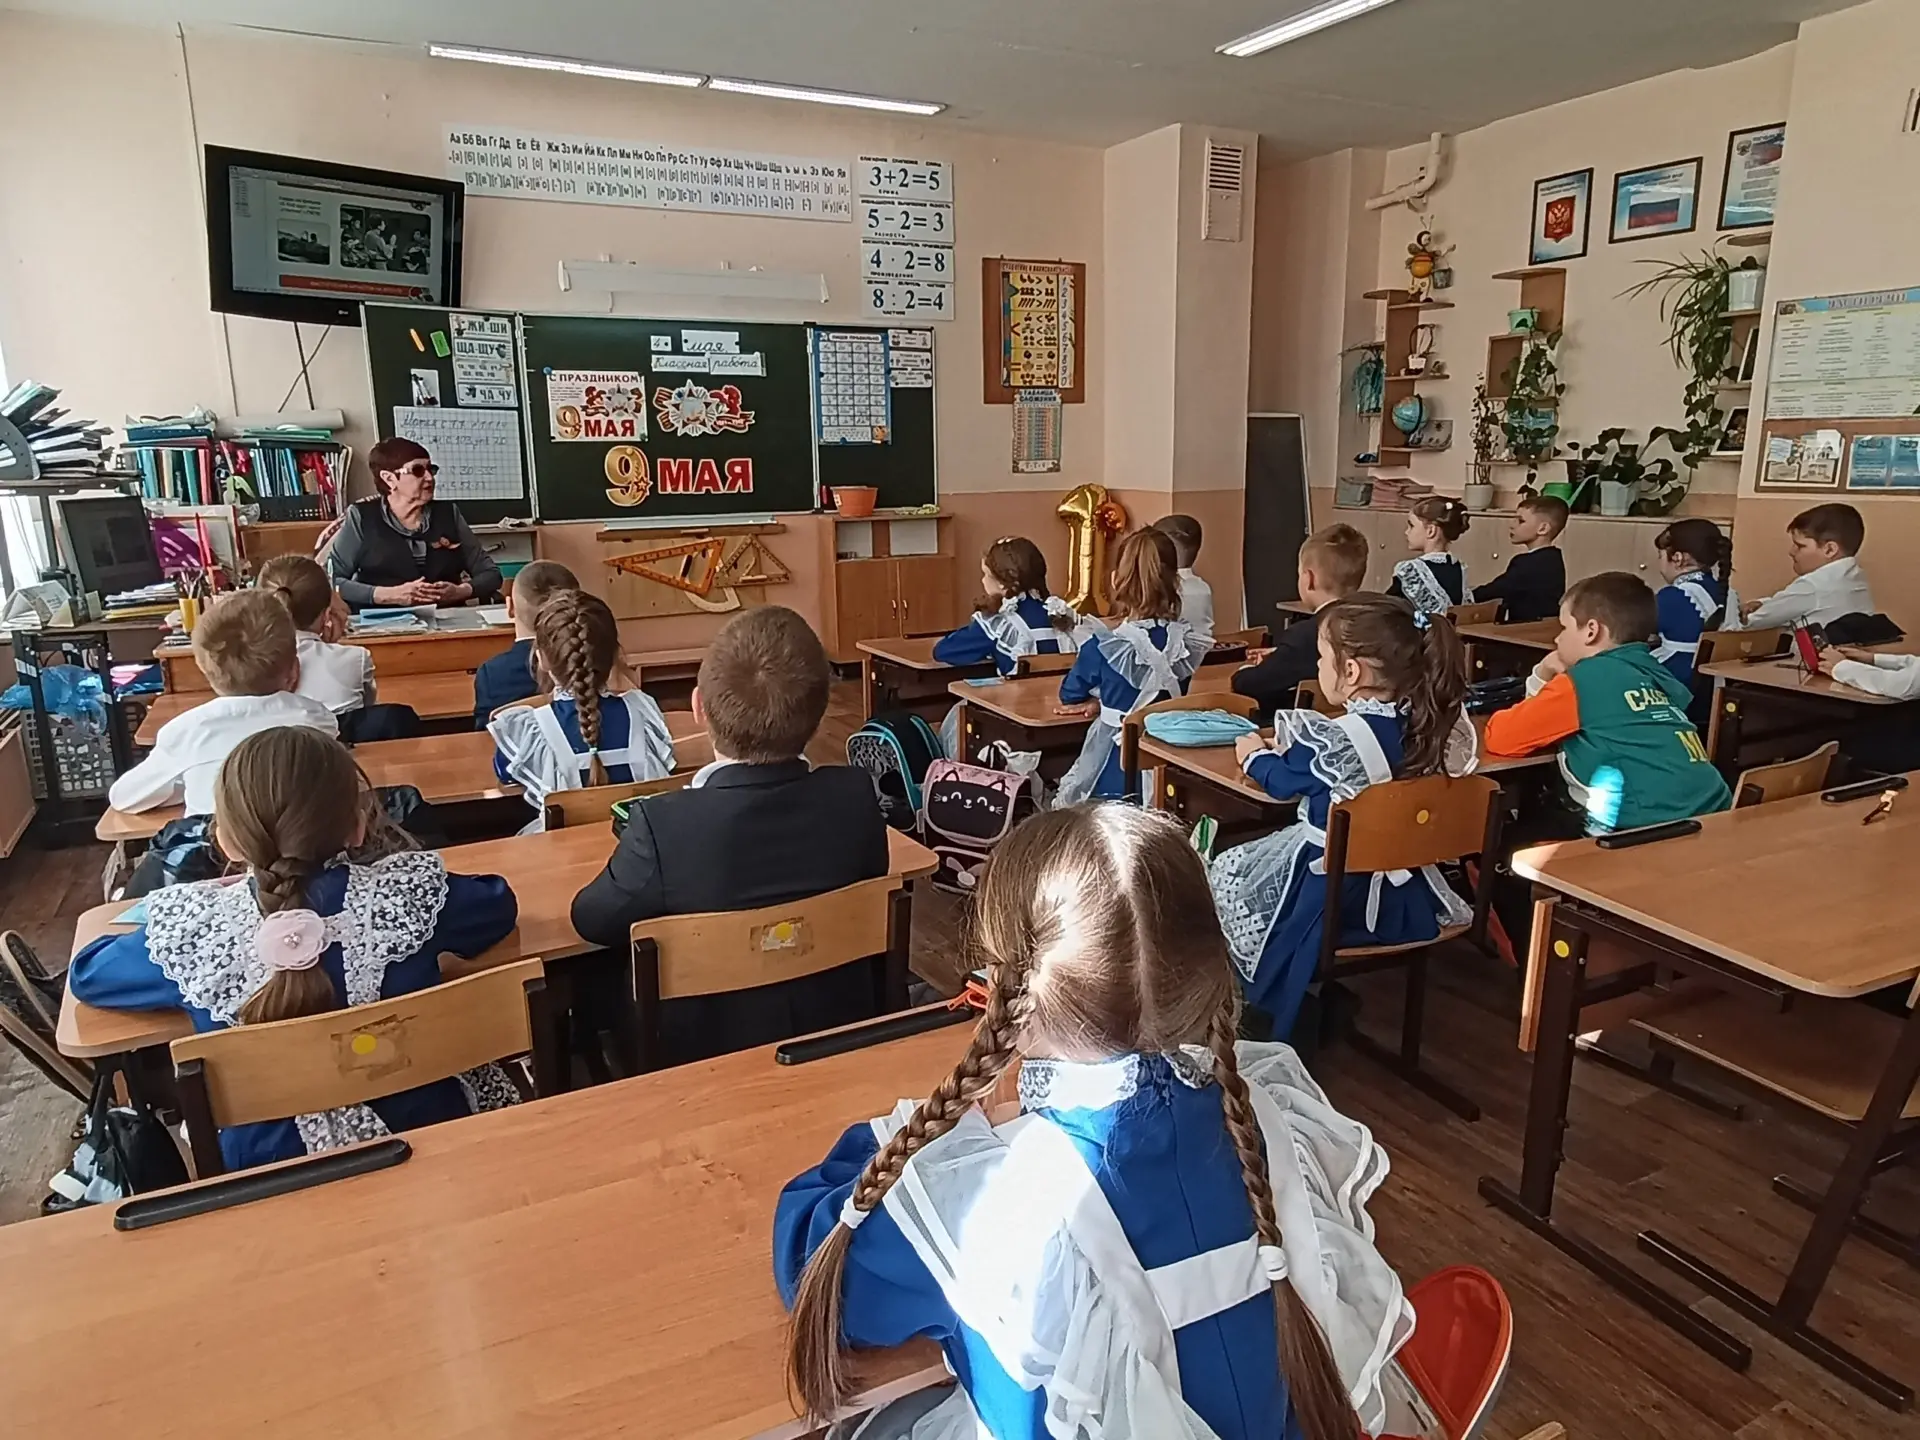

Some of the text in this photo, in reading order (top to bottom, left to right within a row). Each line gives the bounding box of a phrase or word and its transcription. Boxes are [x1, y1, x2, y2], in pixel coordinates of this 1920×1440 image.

[655, 356, 758, 372] Классная работа
[556, 405, 634, 439] 9 МАЯ
[604, 445, 753, 506] 9 МАЯ
